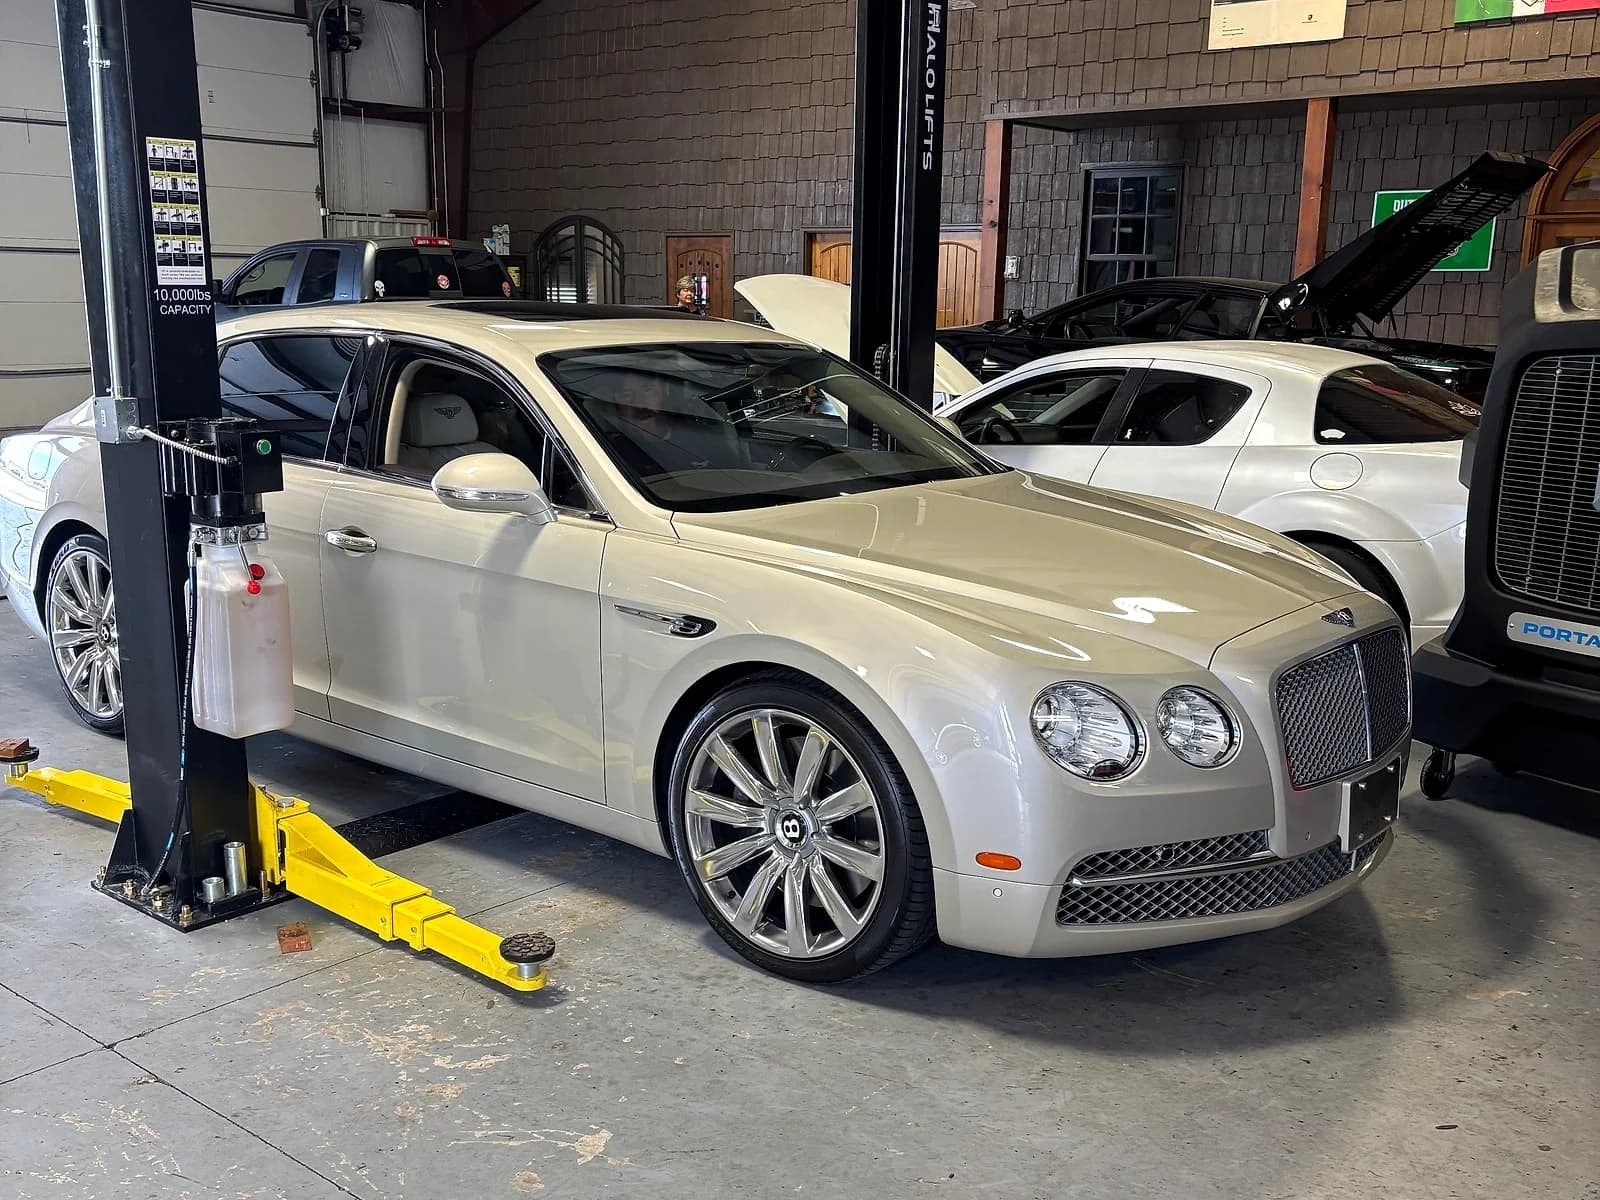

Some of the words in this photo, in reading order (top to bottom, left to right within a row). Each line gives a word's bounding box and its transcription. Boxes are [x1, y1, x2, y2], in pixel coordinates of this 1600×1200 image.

[925, 2, 942, 89] HALO
[922, 93, 935, 171] LIFTS
[153, 288, 212, 303] 10,000lbs
[159, 304, 212, 315] CAPACITY
[1522, 622, 1600, 648] PORTA
